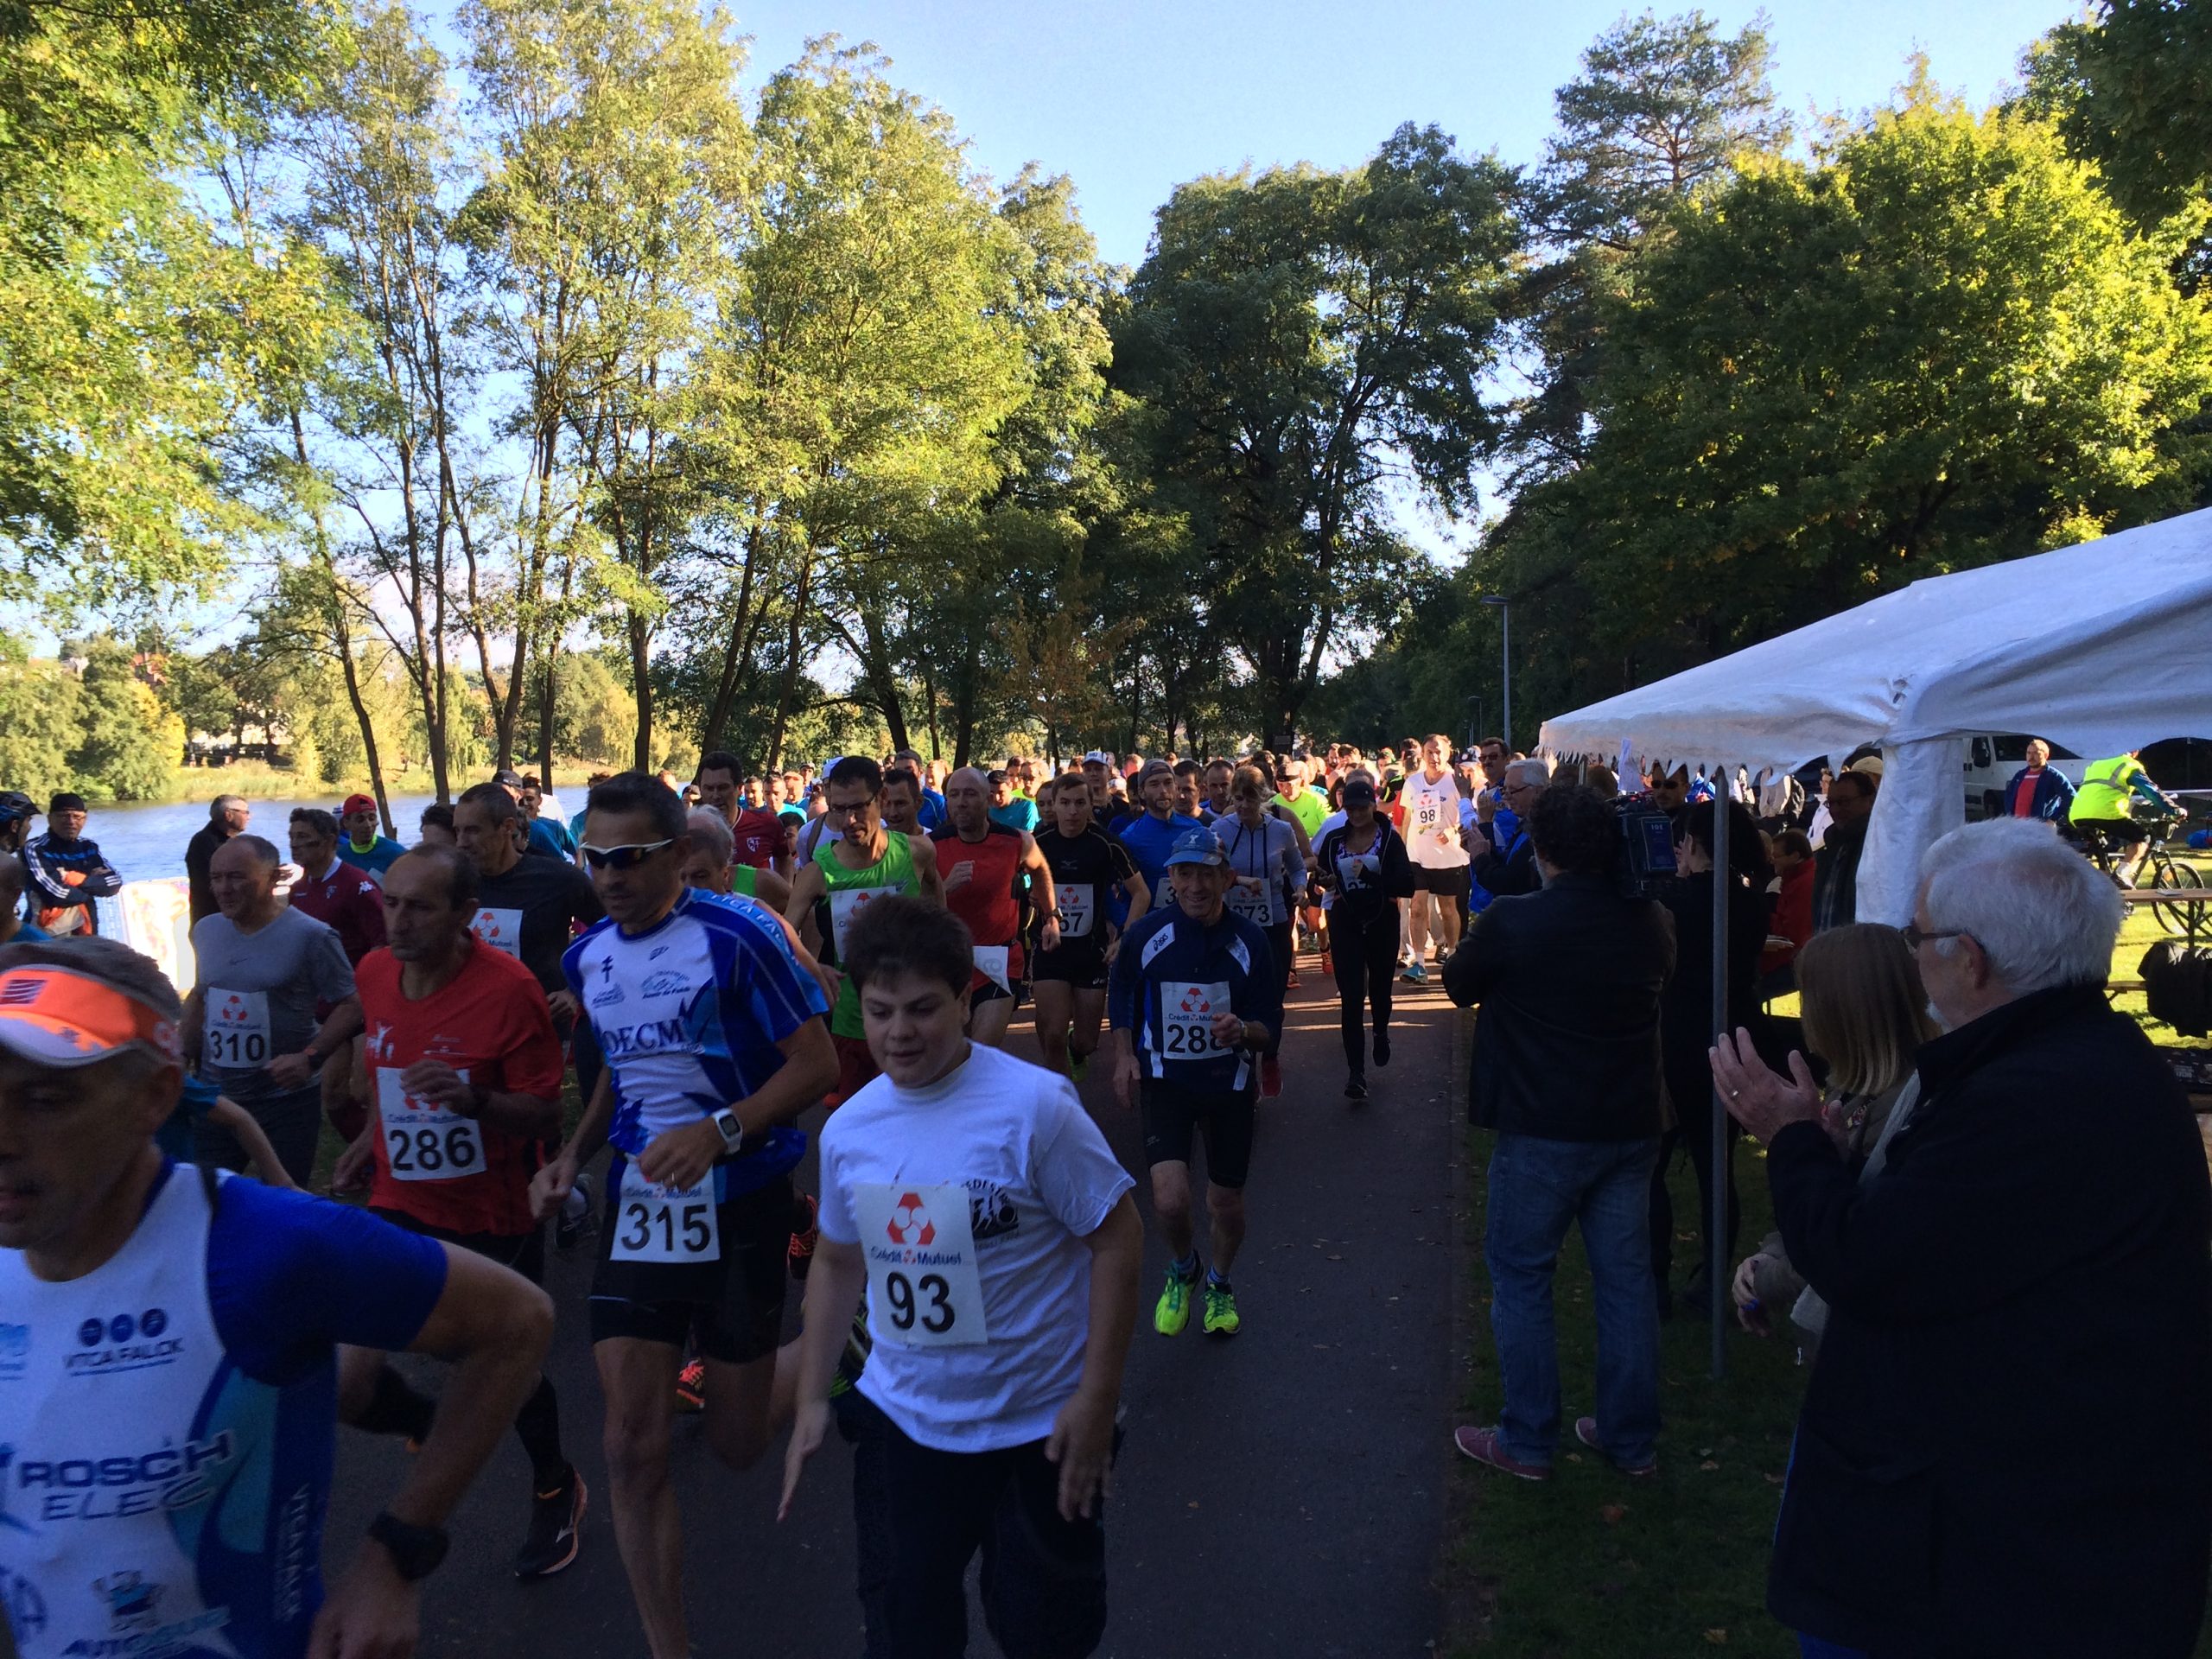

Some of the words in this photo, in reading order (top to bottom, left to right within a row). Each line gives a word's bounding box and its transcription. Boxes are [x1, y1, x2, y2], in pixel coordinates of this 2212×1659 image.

[1420, 809, 1436, 823] 98
[210, 1030, 264, 1062] 310
[390, 1126, 475, 1172] 286
[620, 1202, 711, 1252] 315
[887, 1271, 956, 1332] 93
[19, 1431, 231, 1489] ROSCH
